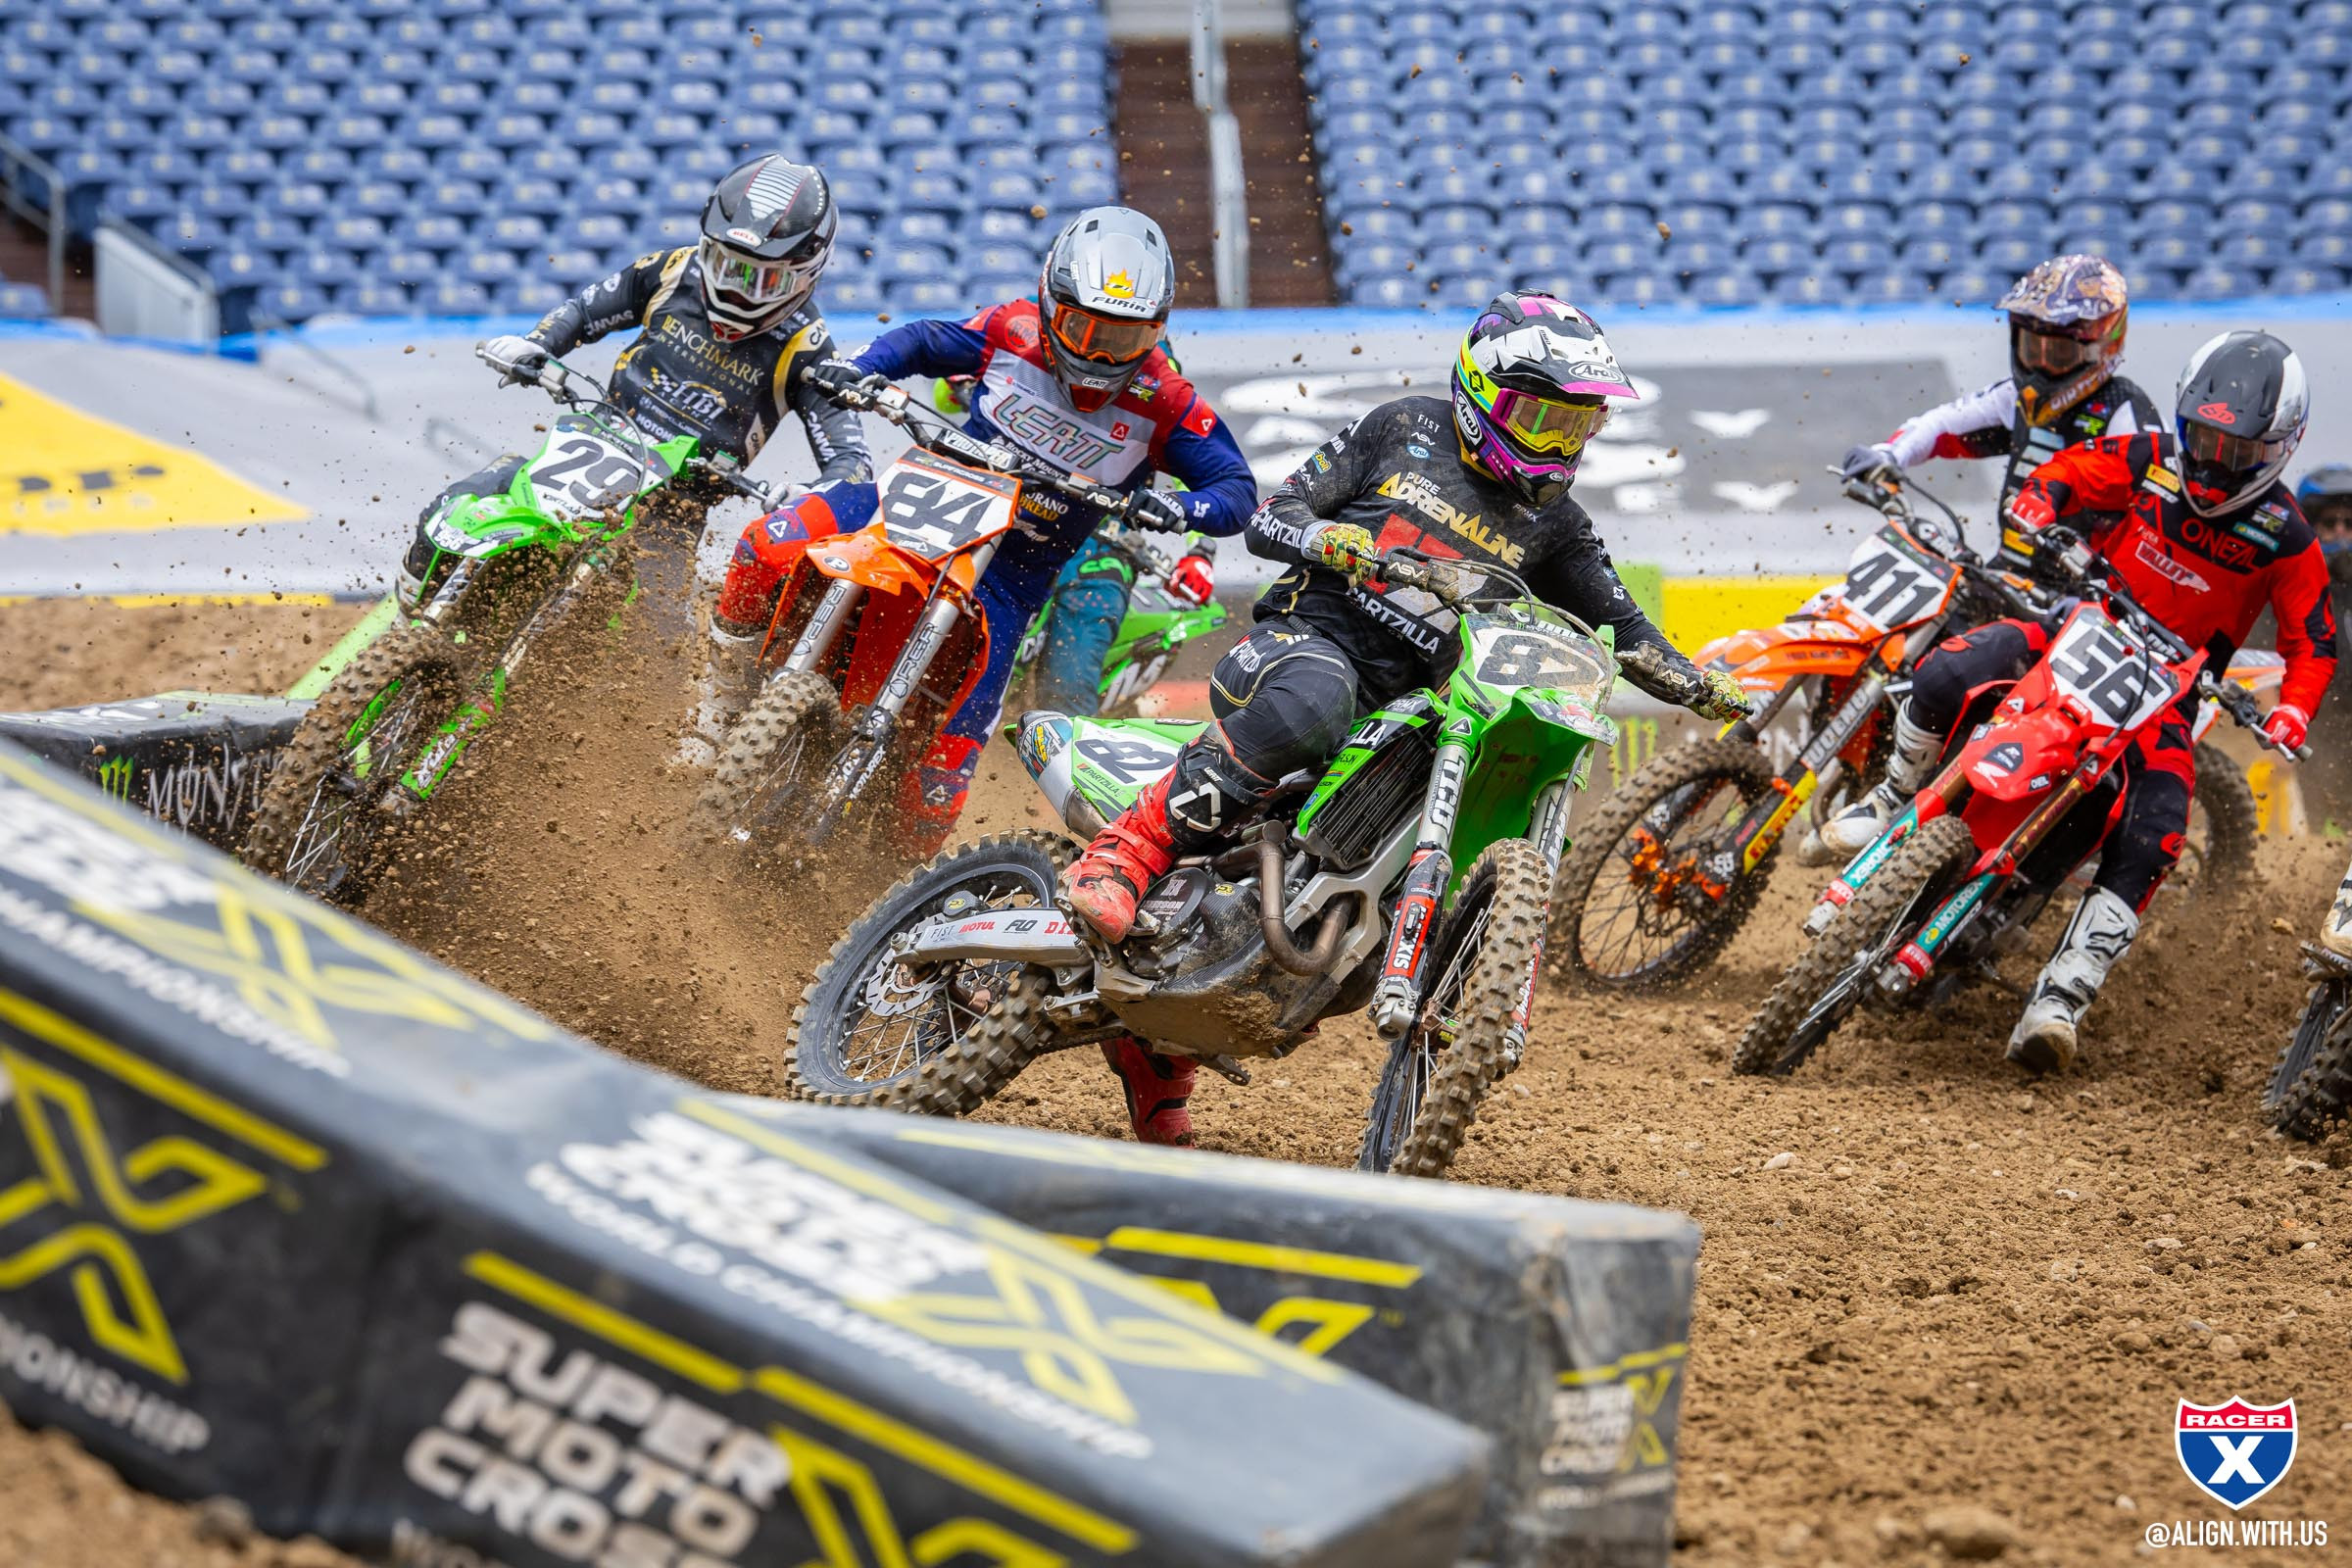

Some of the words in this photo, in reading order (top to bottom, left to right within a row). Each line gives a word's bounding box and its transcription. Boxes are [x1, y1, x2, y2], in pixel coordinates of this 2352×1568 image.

[662, 315, 764, 386] BENCHMARK
[1581, 365, 1620, 379] Arai
[993, 392, 1126, 470] LEATT
[1411, 432, 1436, 446] ASV
[1418, 415, 1441, 432] FIST
[1456, 397, 1480, 439] Arai
[529, 439, 641, 509] 29
[1033, 458, 1070, 480] MOUNT
[1405, 471, 1441, 495] PURE
[882, 471, 995, 547] 84
[1087, 492, 1120, 508] ASV
[1376, 471, 1525, 569] ADRENALINE
[1388, 562, 1424, 578] ASV
[1841, 551, 1941, 629] 411
[1661, 669, 1696, 688] ASV
[2049, 627, 2165, 723] 56
[1085, 767, 1119, 797] PARTZILLA
[1849, 839, 1897, 885] OTOREX
[1937, 879, 1984, 932] MOTOREX
[930, 923, 955, 939] FIST
[958, 921, 996, 934] MOTUL
[440, 1301, 791, 1509] SUPER
[444, 1377, 760, 1559] MOTO
